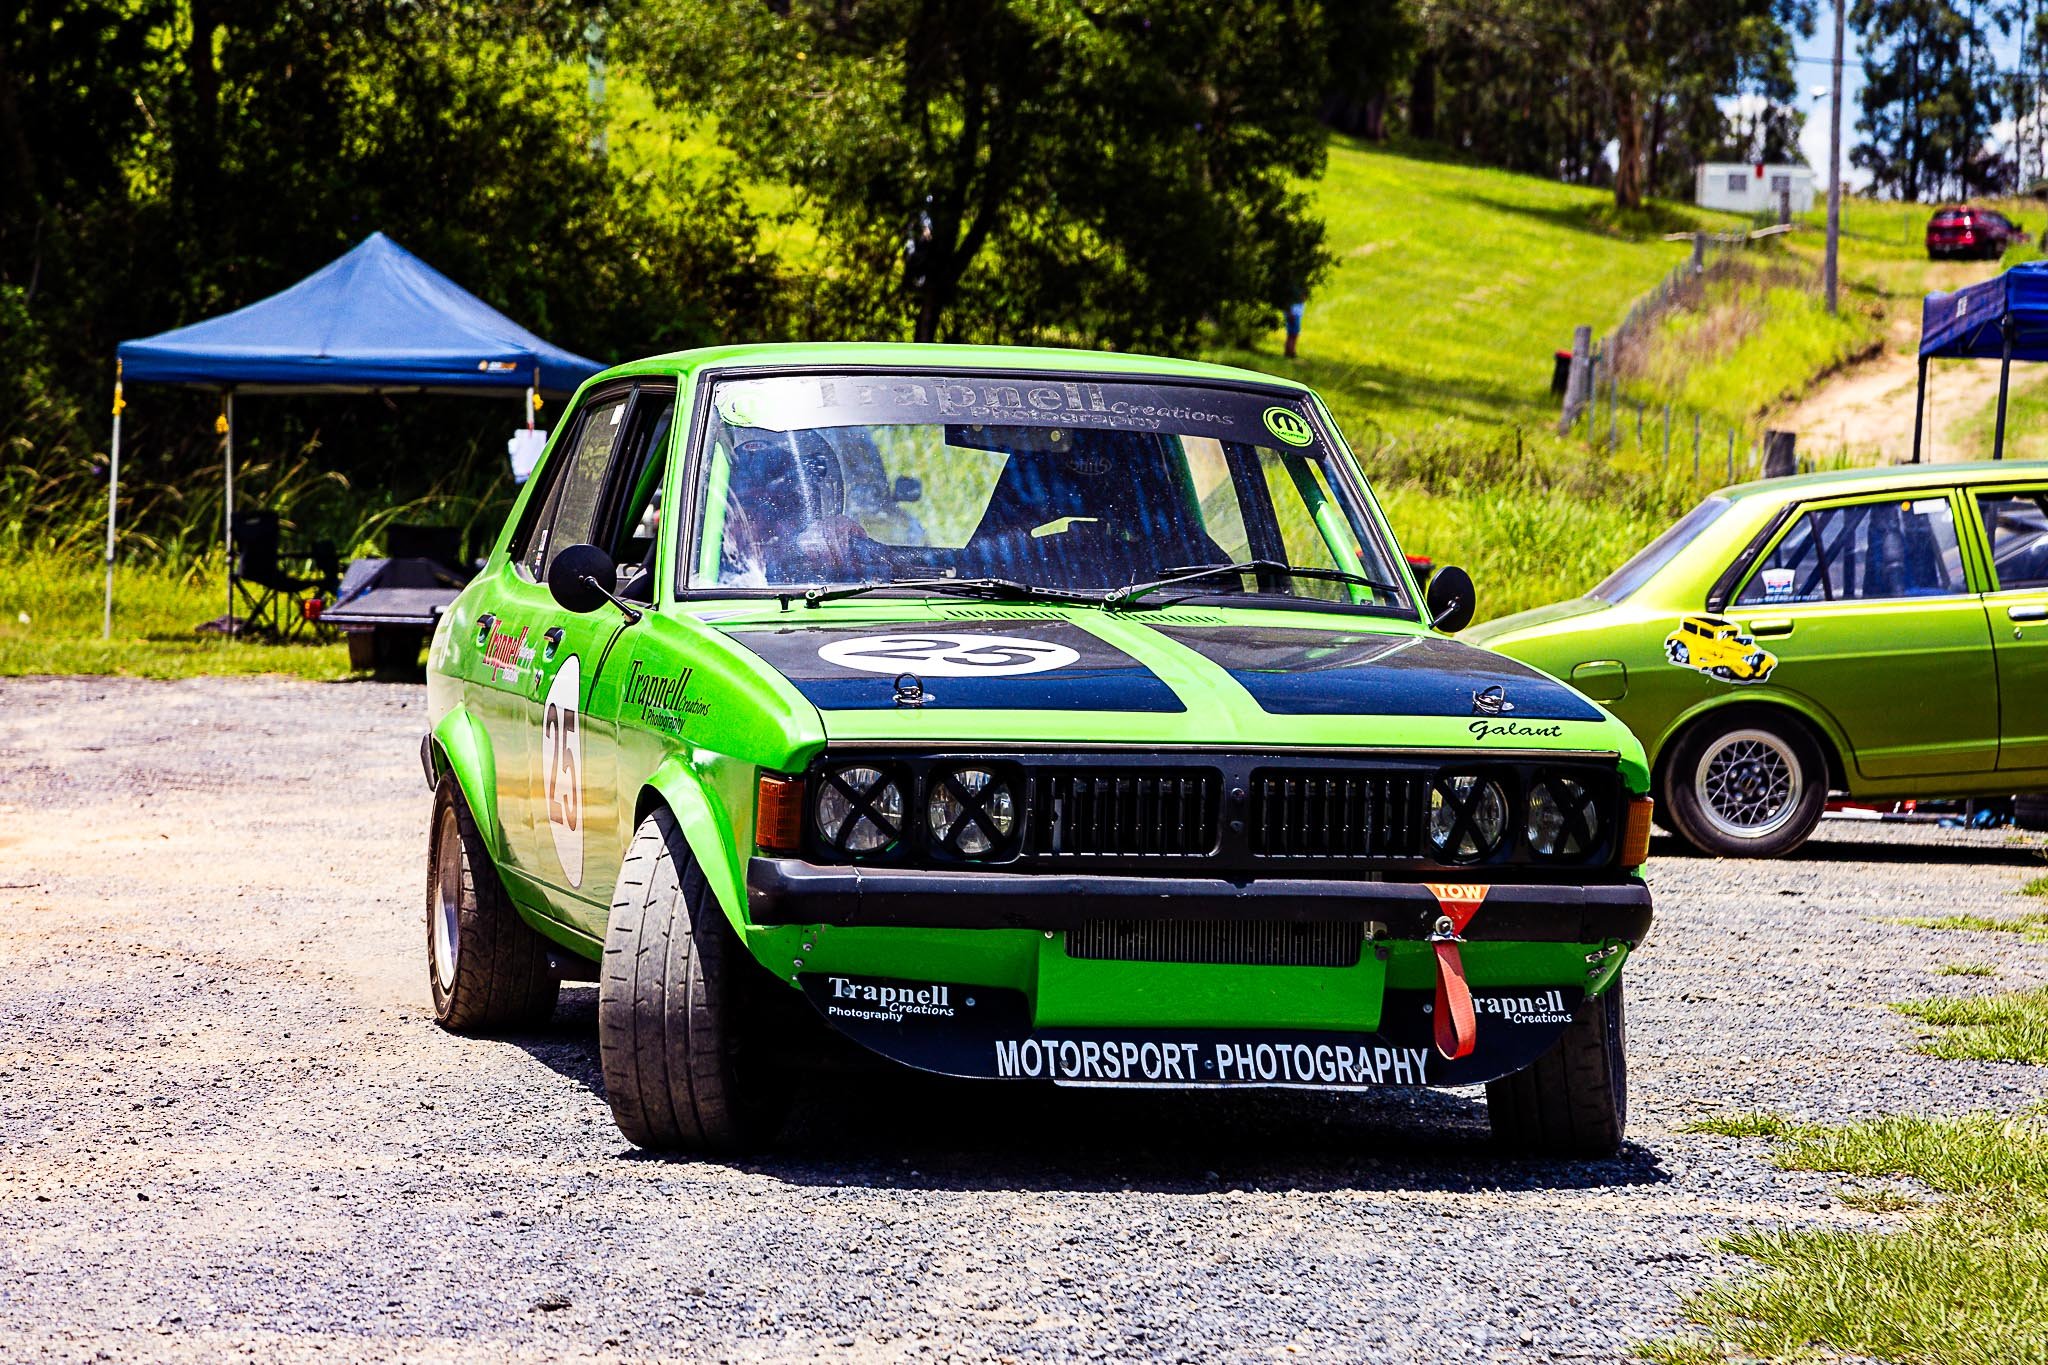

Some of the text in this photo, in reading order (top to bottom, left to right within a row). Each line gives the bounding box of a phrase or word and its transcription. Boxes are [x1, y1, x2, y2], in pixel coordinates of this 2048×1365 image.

[1111, 400, 1234, 425] Creations
[843, 639, 1056, 666] 25
[624, 660, 711, 720] Trapnell Creations
[646, 709, 685, 734] Photography
[1469, 720, 1562, 741] Galant
[546, 703, 578, 831] 25
[1437, 885, 1481, 899] TOW
[828, 977, 954, 1016] Trapnell Creations
[1470, 990, 1572, 1023] rapnell Creations
[828, 1006, 903, 1022] Photography
[995, 1039, 1428, 1084] MOTORSPORT PHOTOGRAPHY
